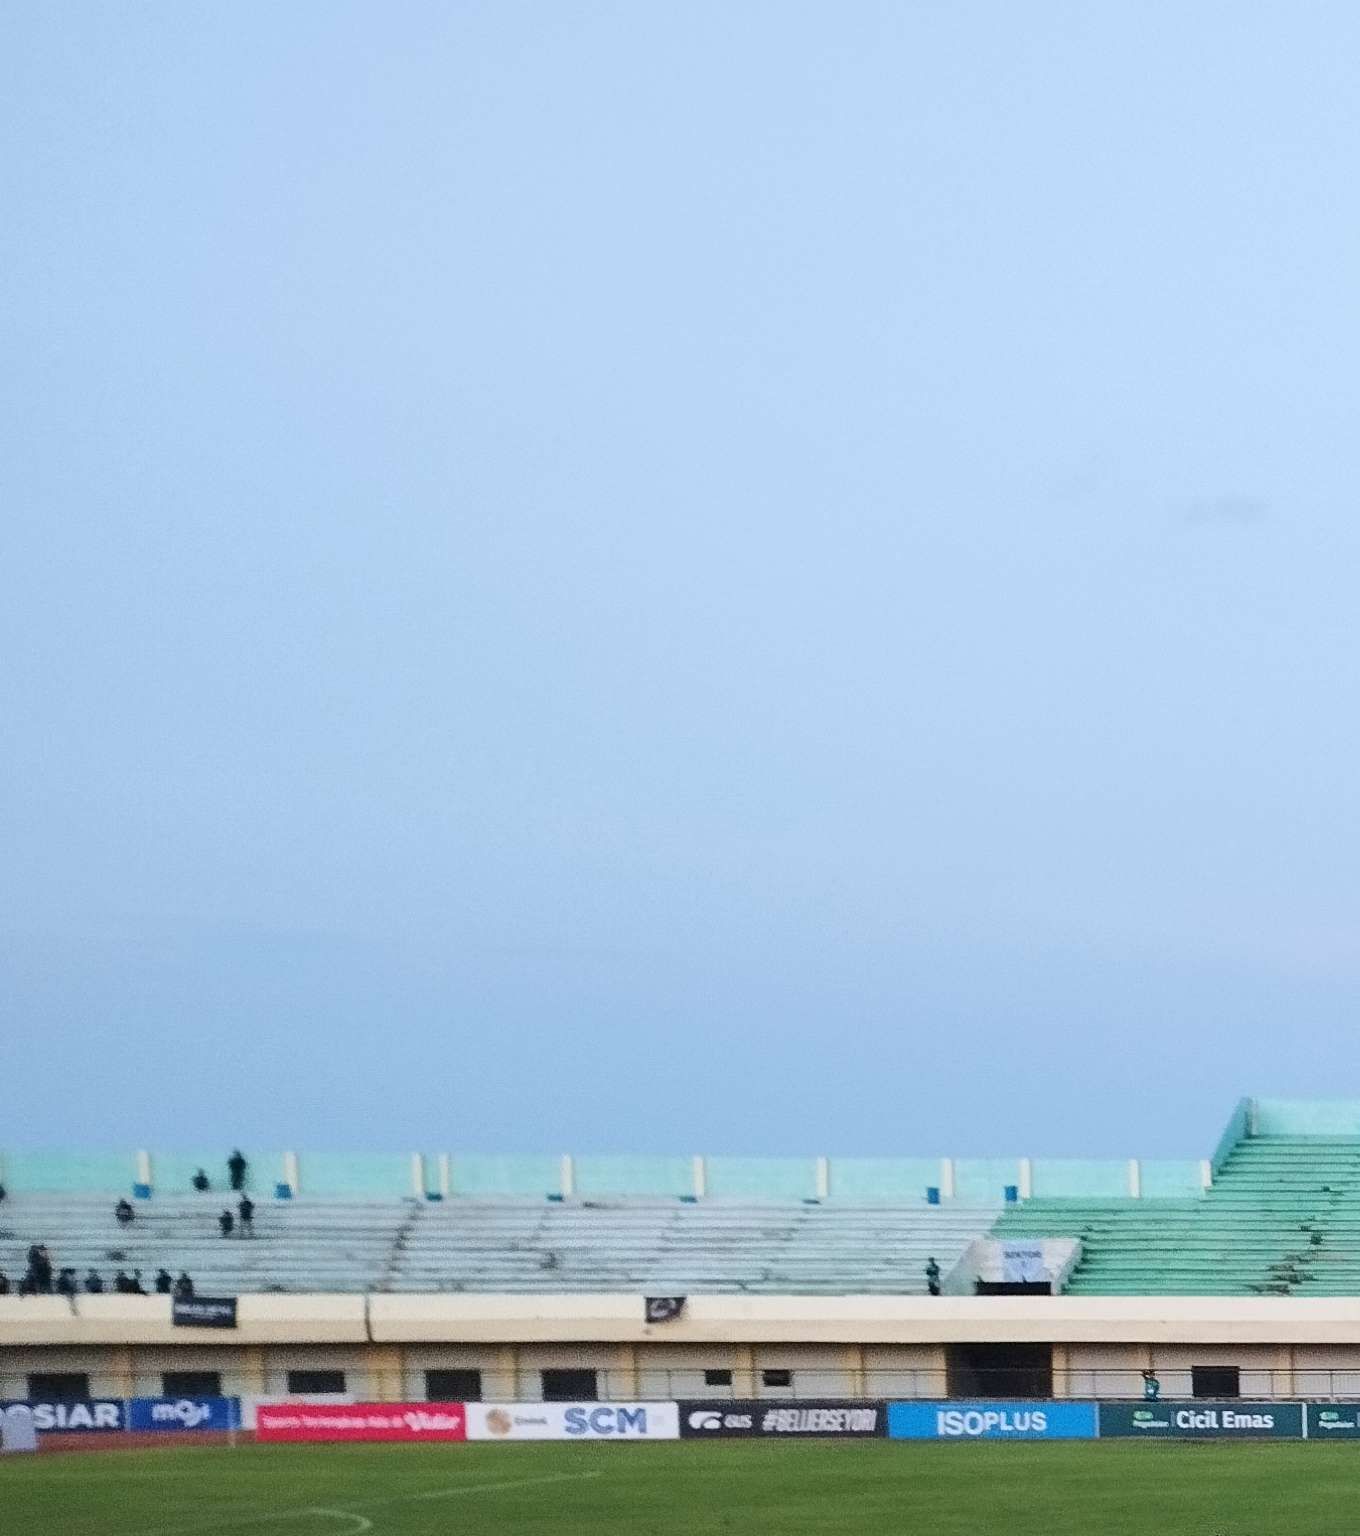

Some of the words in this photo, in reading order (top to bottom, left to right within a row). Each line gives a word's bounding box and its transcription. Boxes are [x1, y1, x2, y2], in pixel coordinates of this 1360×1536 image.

[564, 1407, 647, 1435] SCM
[937, 1410, 1047, 1436] ISOPLUS
[1176, 1410, 1219, 1429] Cicil
[1222, 1411, 1274, 1429] Emas
